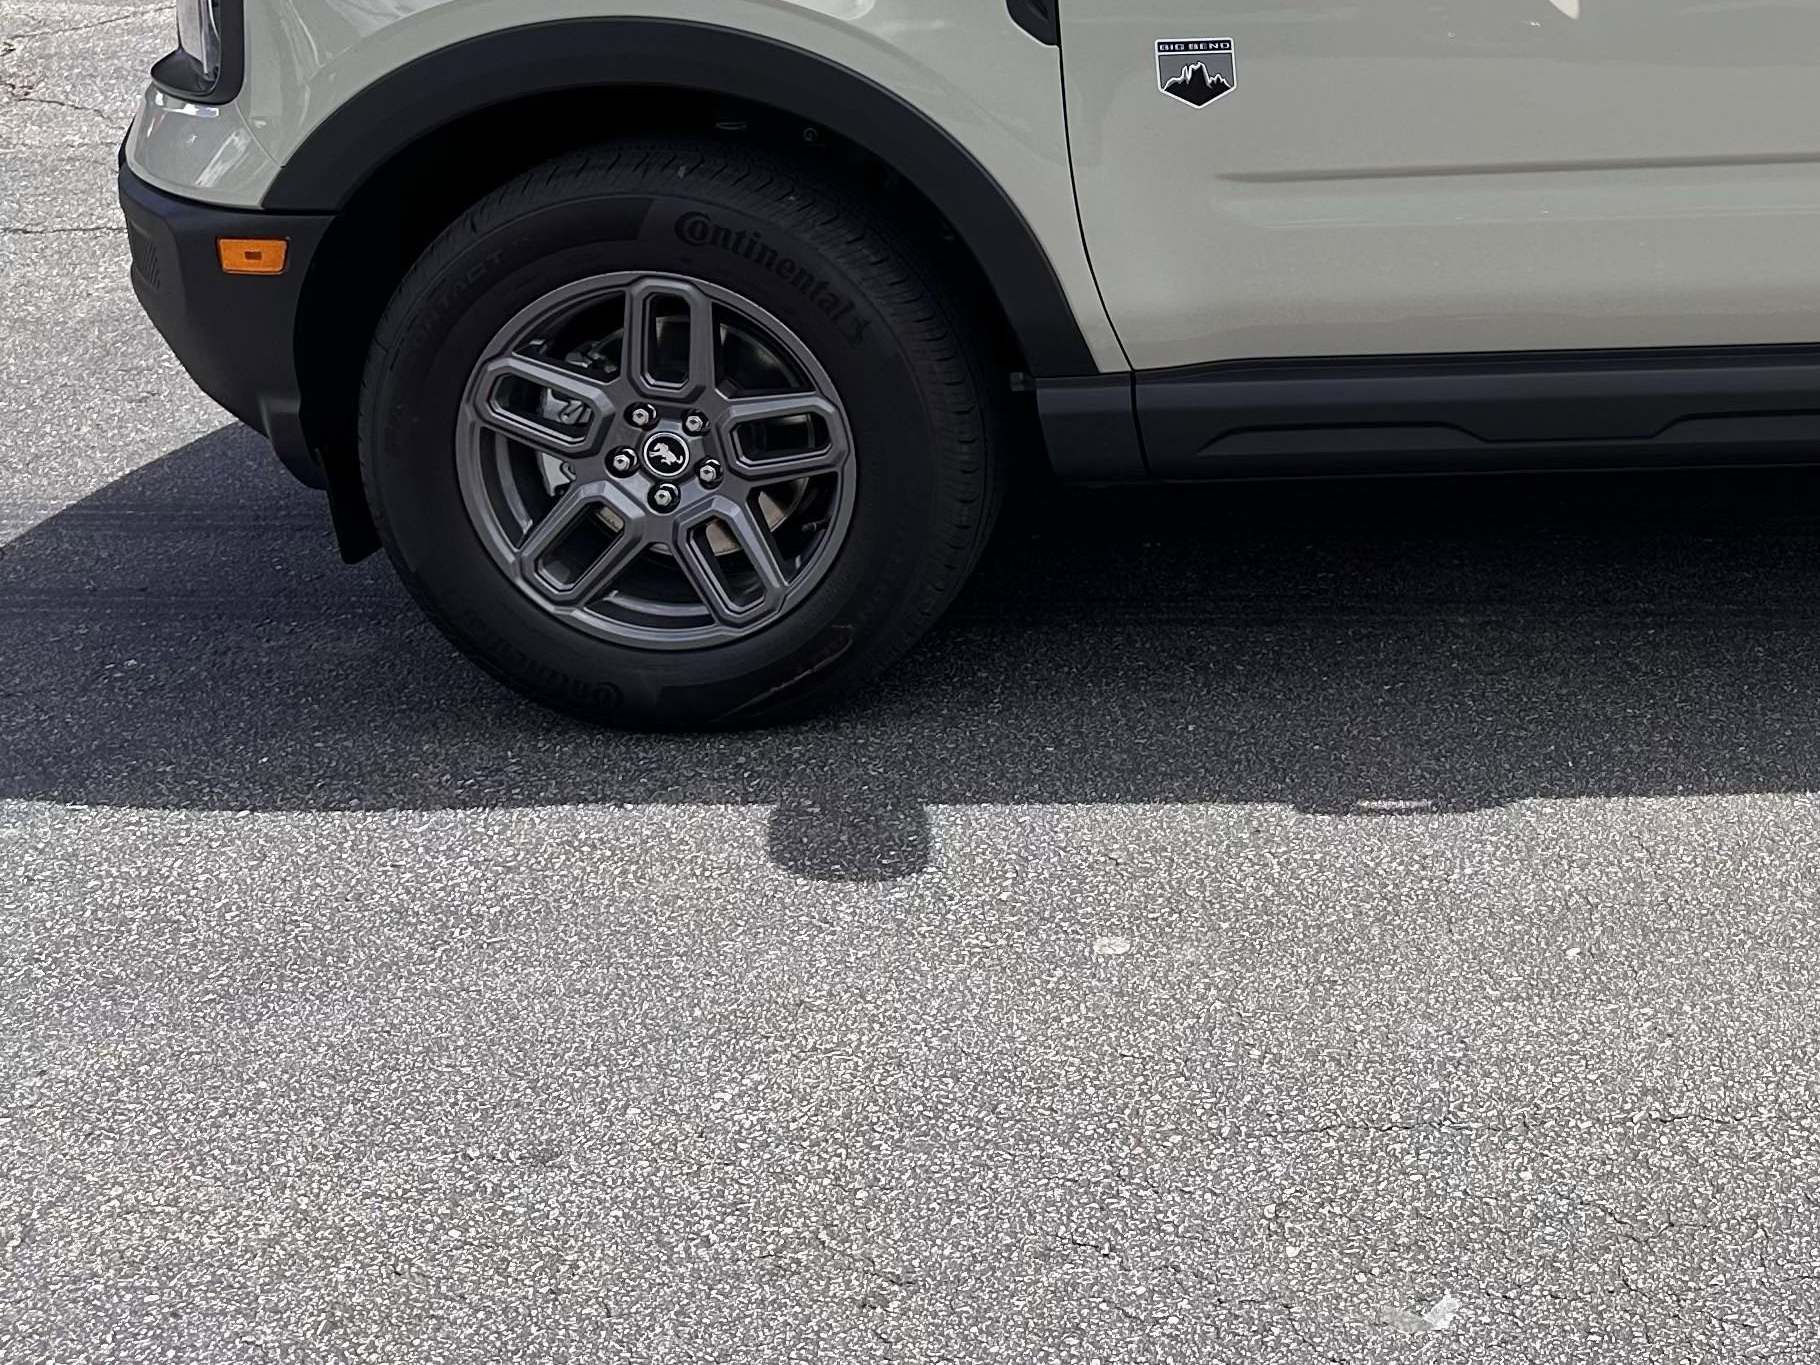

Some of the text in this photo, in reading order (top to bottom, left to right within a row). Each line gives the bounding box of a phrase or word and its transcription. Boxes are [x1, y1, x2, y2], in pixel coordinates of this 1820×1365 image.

[1159, 41, 1230, 51] BIG BEND
[673, 211, 856, 324] Continental
